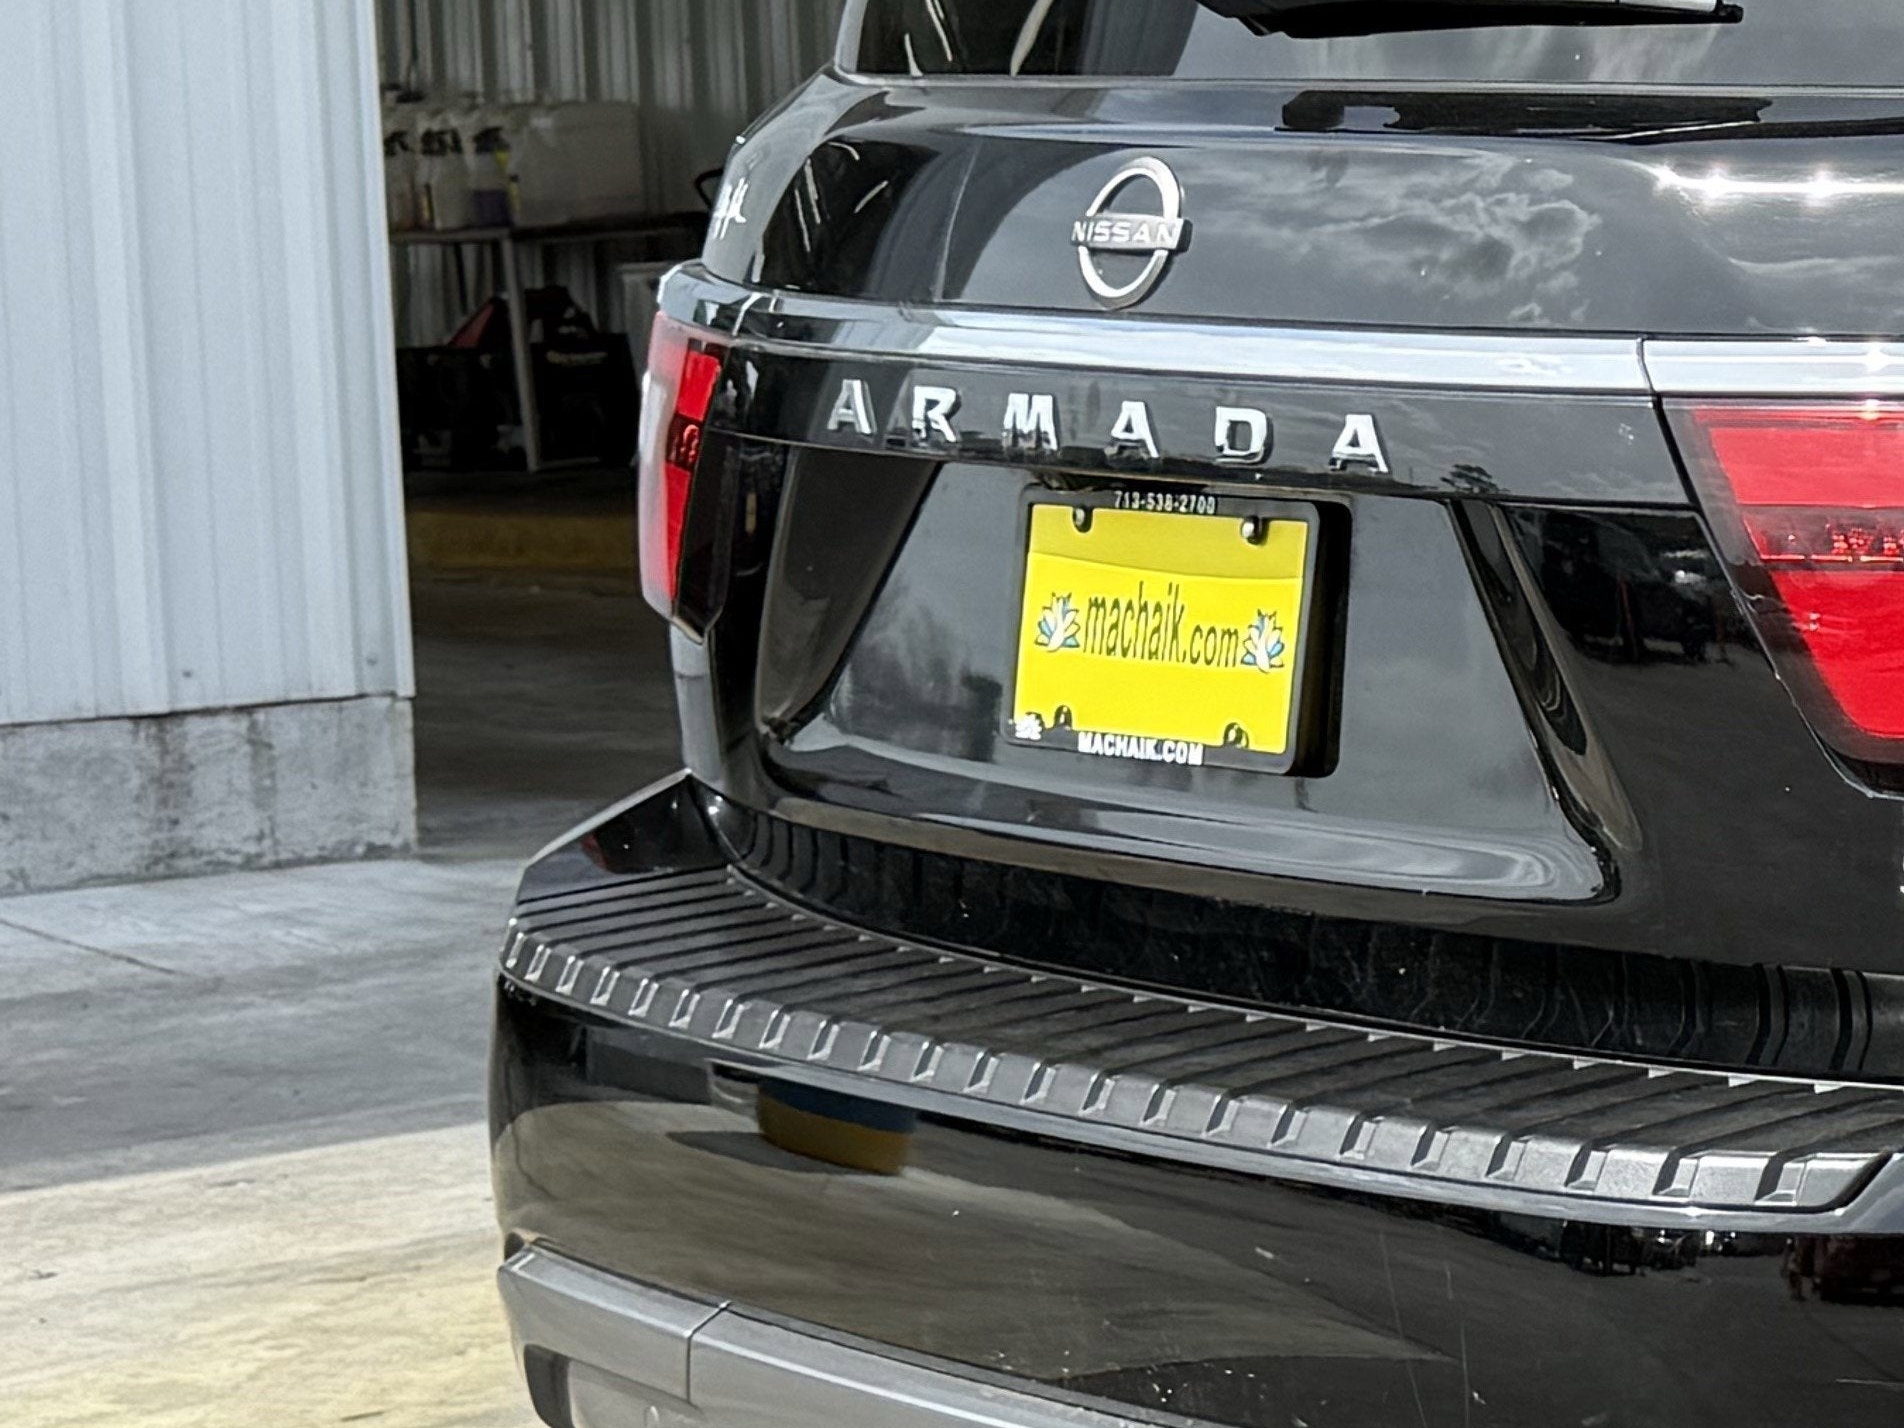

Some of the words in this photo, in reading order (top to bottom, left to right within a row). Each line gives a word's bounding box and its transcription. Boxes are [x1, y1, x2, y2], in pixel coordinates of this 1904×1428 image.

[1071, 219, 1176, 244] NISSAN
[827, 378, 1390, 473] ARMADA
[1083, 580, 1240, 668] machaik.com
[1077, 731, 1204, 766] MACHAIK.COM
